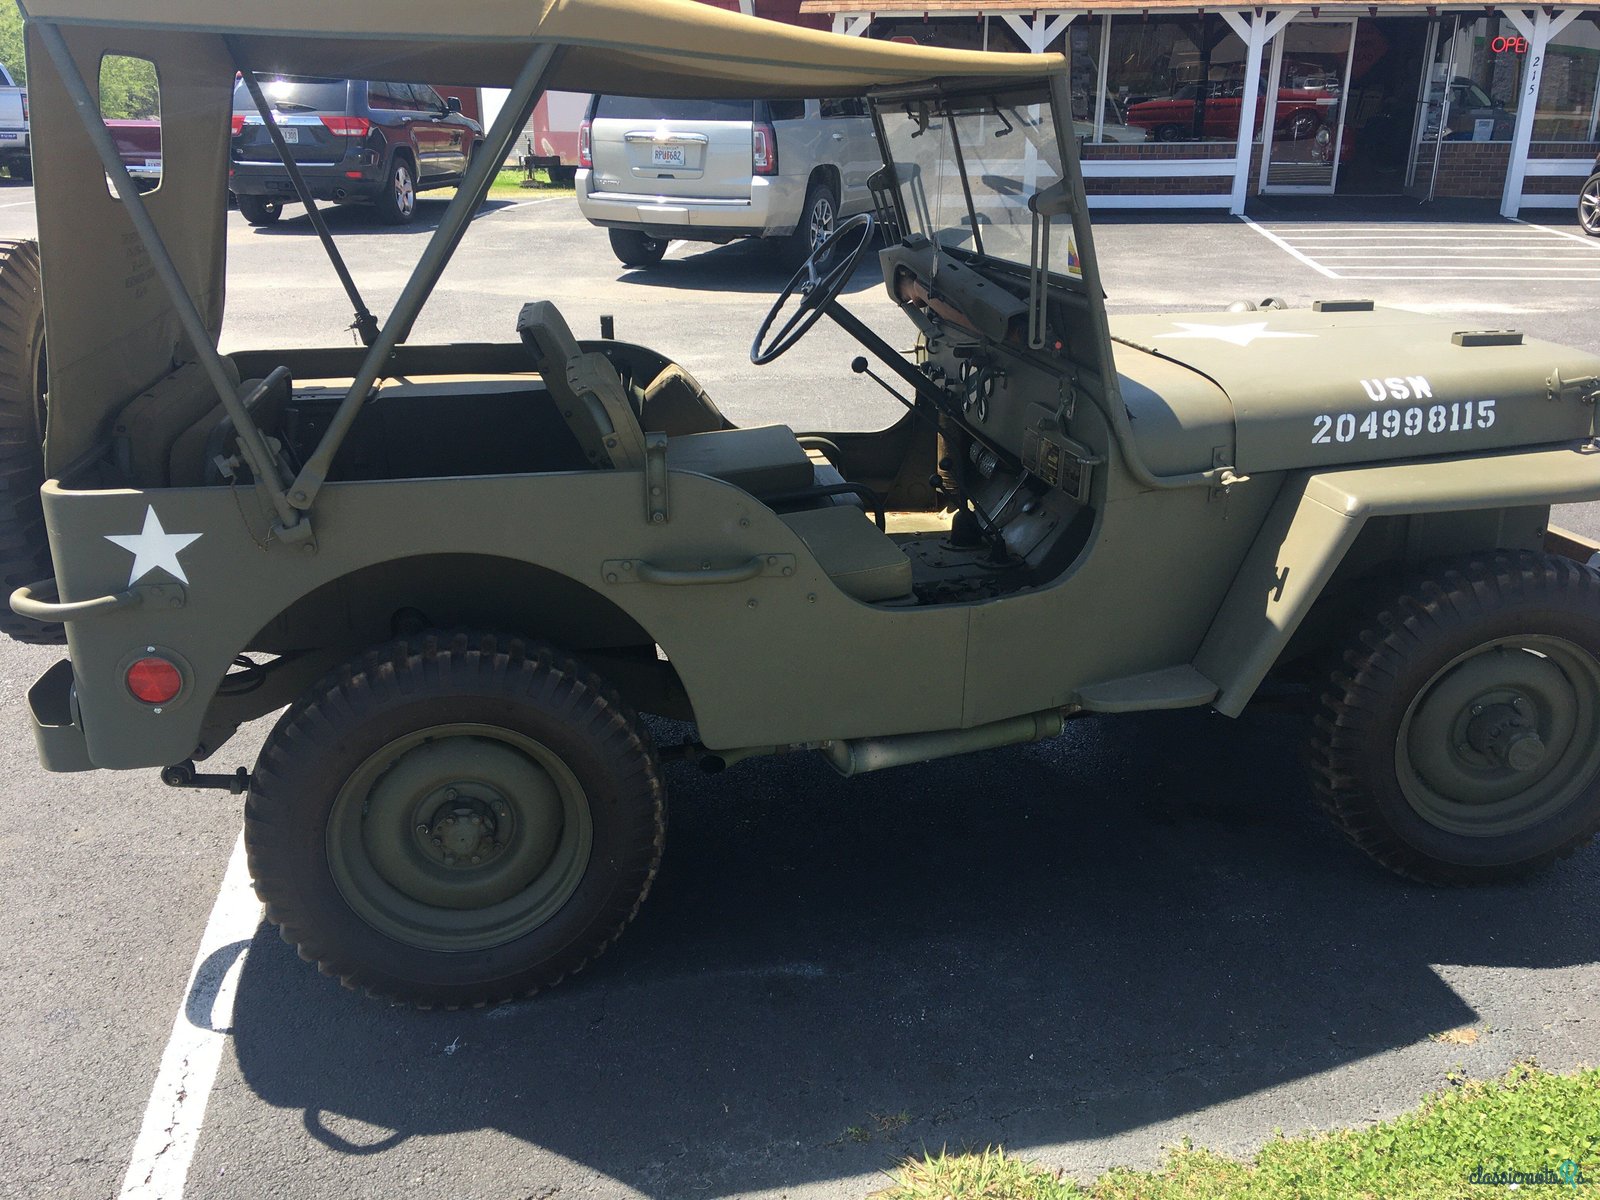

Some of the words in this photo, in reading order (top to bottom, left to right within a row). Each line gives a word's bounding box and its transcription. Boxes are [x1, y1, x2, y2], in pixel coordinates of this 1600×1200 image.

[1528, 56, 1540, 95] 215
[1360, 376, 1433, 402] USN
[1311, 400, 1496, 444] 204998115
